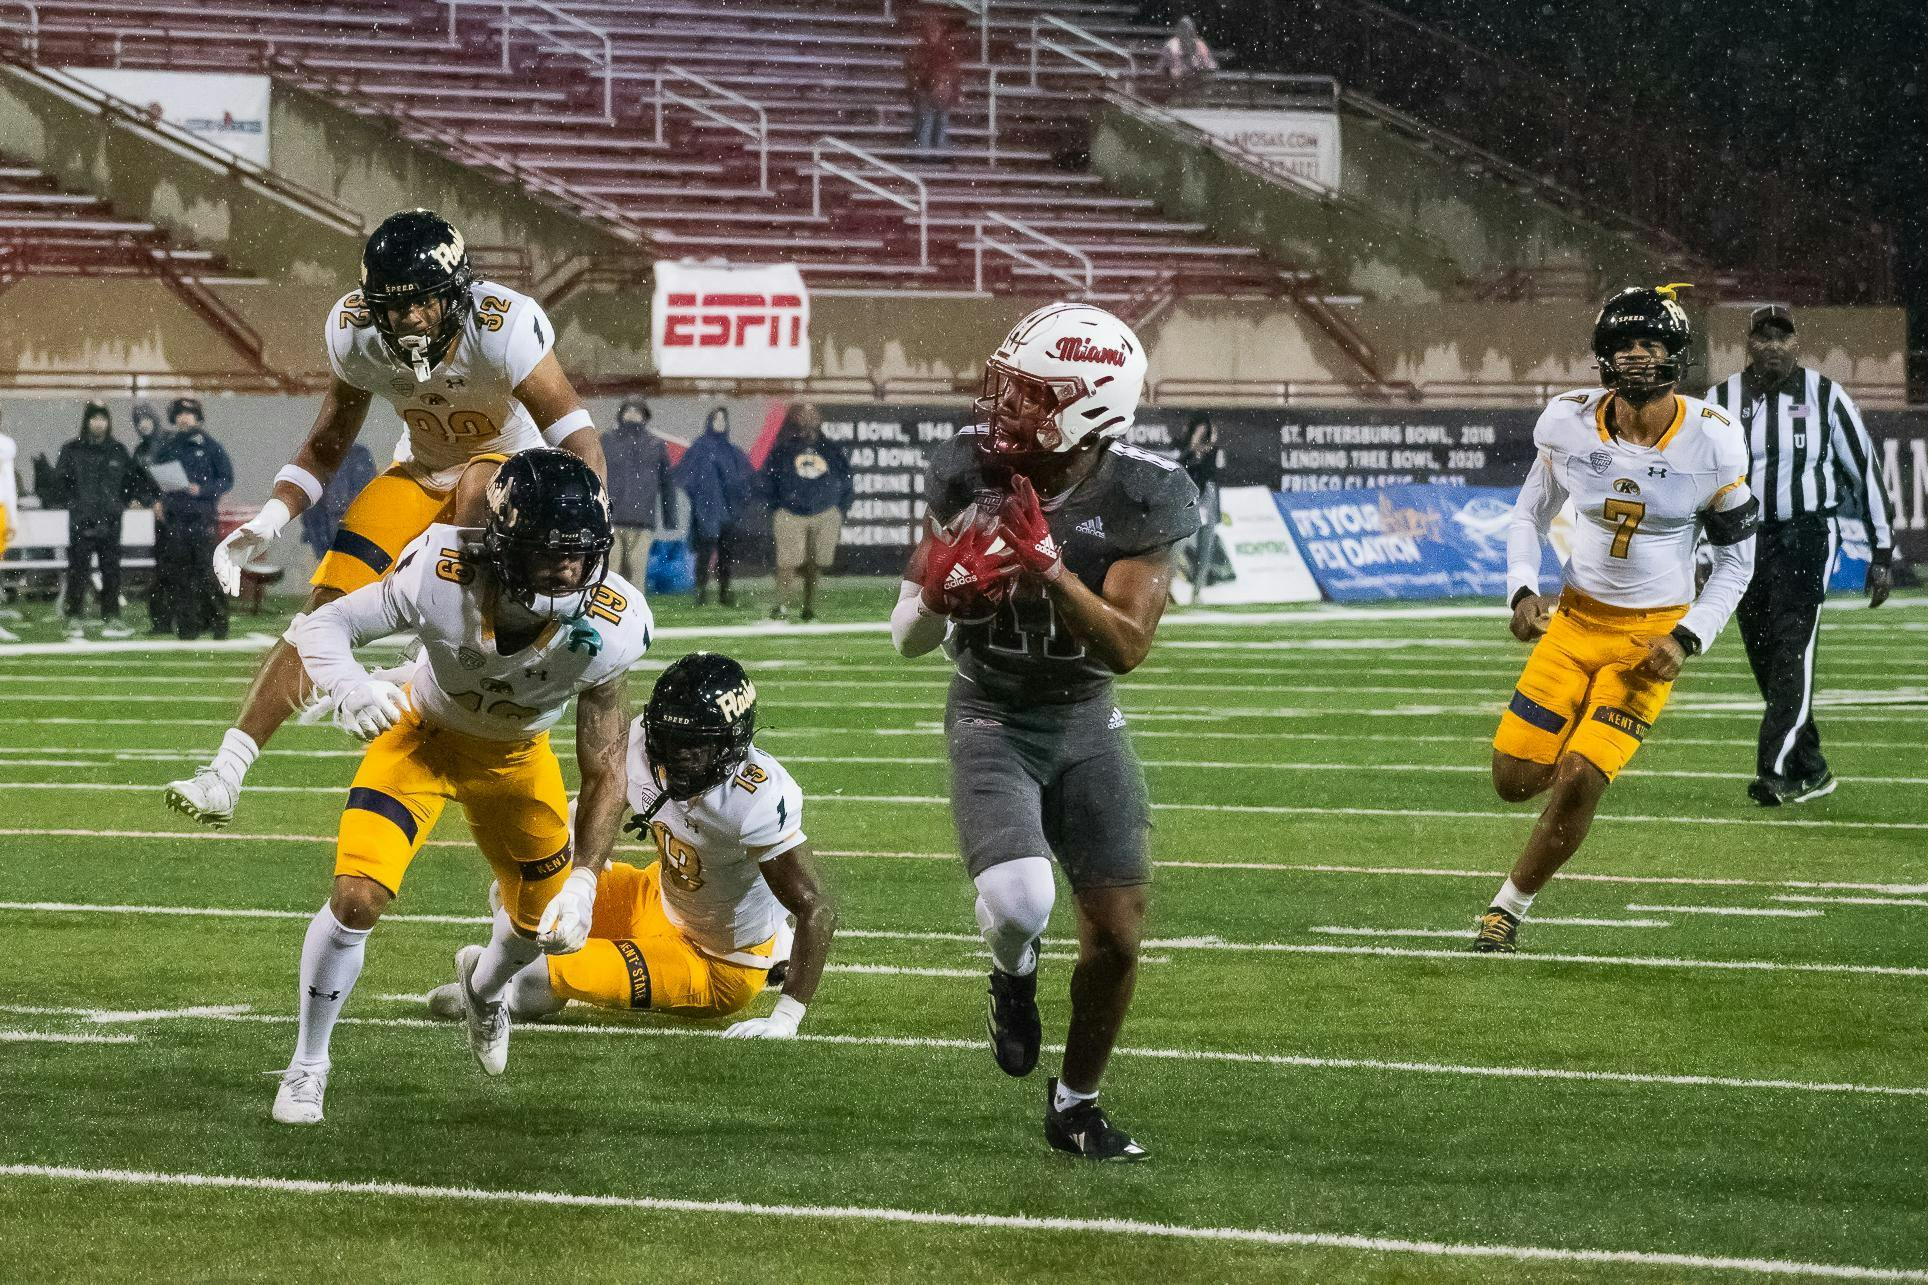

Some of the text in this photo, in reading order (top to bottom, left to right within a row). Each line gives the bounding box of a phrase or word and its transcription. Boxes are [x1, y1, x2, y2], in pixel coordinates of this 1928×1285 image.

[477, 295, 512, 331] 32
[663, 294, 801, 346] ESPN
[1055, 336, 1126, 367] Miami
[1701, 407, 1731, 427] 7
[1306, 425, 1402, 444] PETERSBURG
[1794, 433, 1806, 448] U
[1281, 450, 1347, 469] LENDING
[1351, 450, 1389, 469] TREE
[1448, 450, 1485, 469] 2020
[1075, 525, 1105, 539] adidas
[1603, 498, 1646, 560] 7
[944, 574, 978, 591] adidas
[585, 585, 628, 626] 19
[663, 715, 690, 725] SPEED
[1607, 711, 1633, 730] KENT
[732, 763, 769, 795] 13
